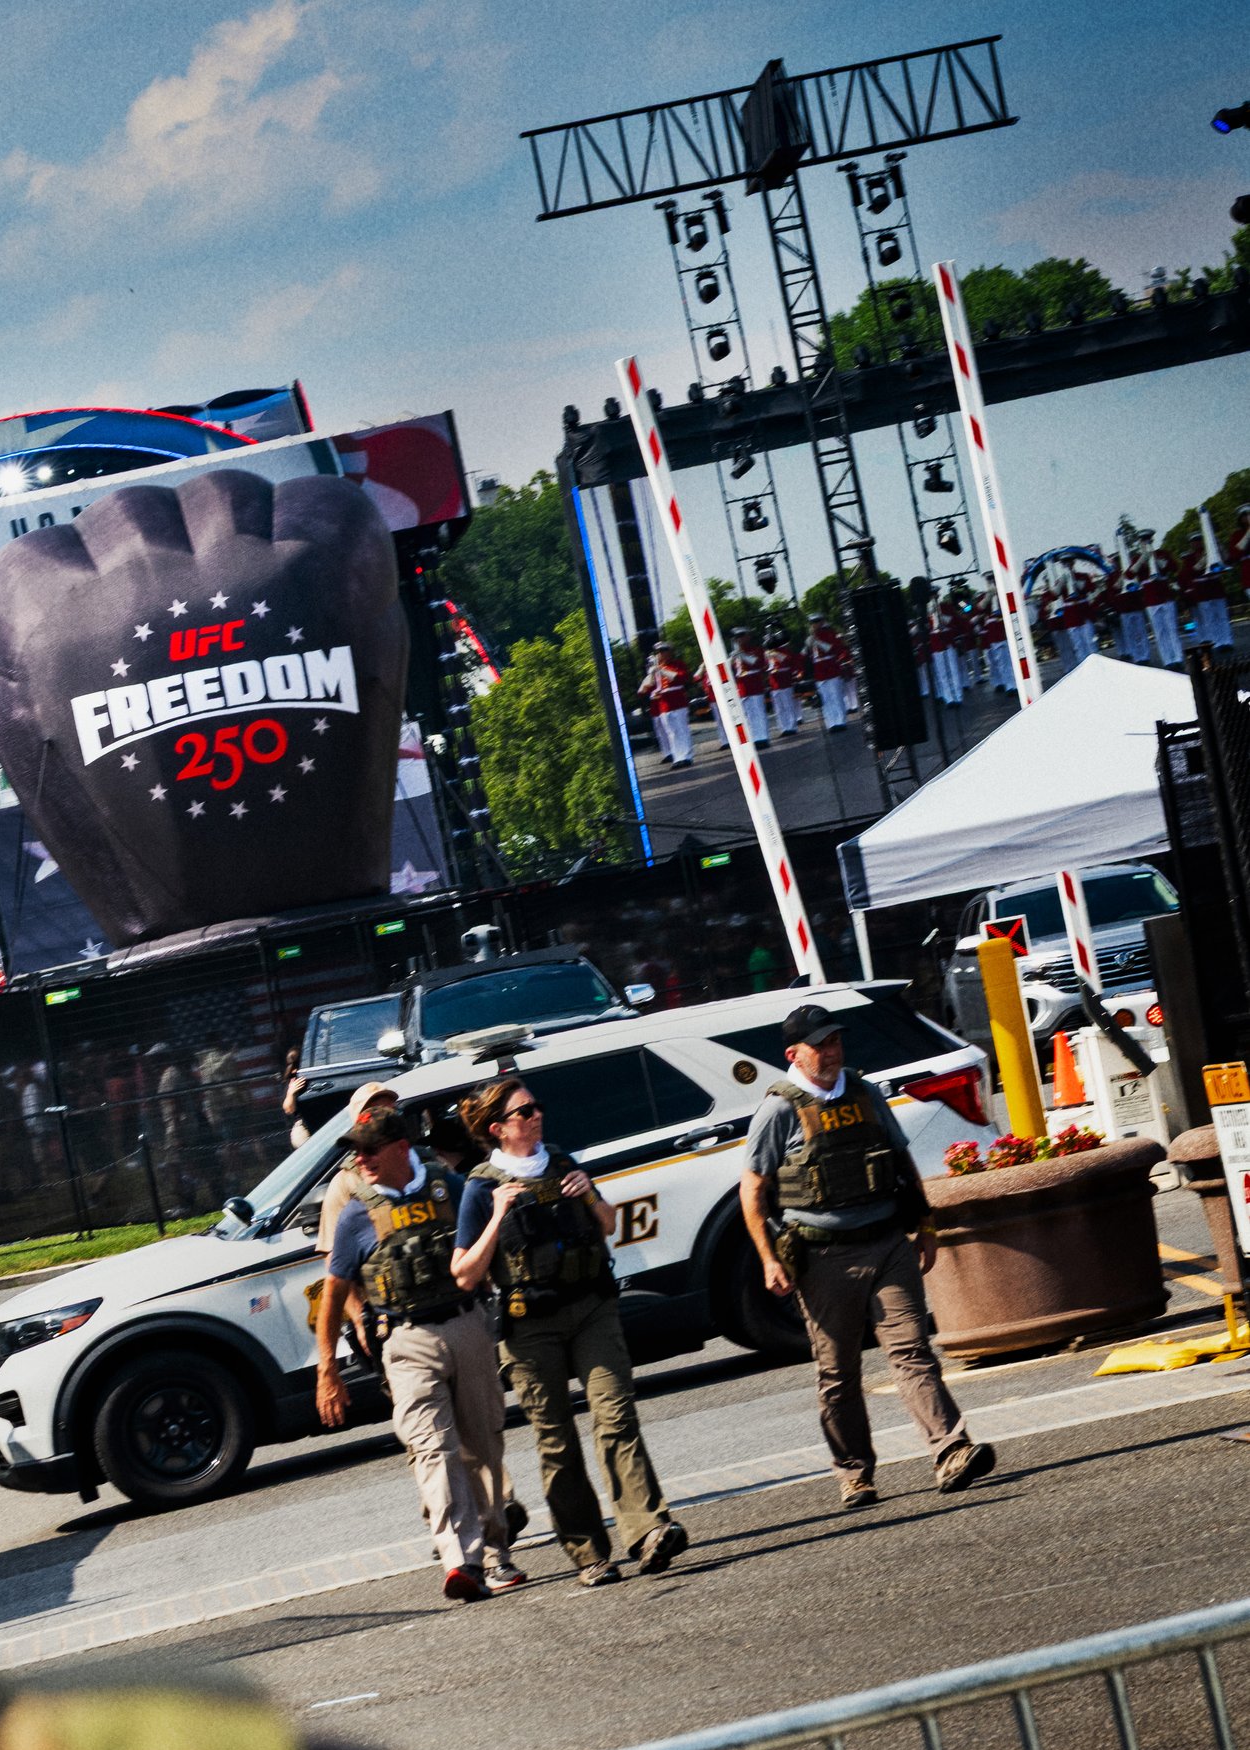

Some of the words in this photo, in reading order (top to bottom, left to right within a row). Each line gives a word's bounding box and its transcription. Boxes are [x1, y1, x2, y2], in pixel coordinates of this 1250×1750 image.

[169, 619, 246, 662] UFC
[70, 645, 360, 767] FREEDOM
[174, 718, 288, 791] 250
[819, 1103, 864, 1132] HSI
[390, 1201, 437, 1231] HSI
